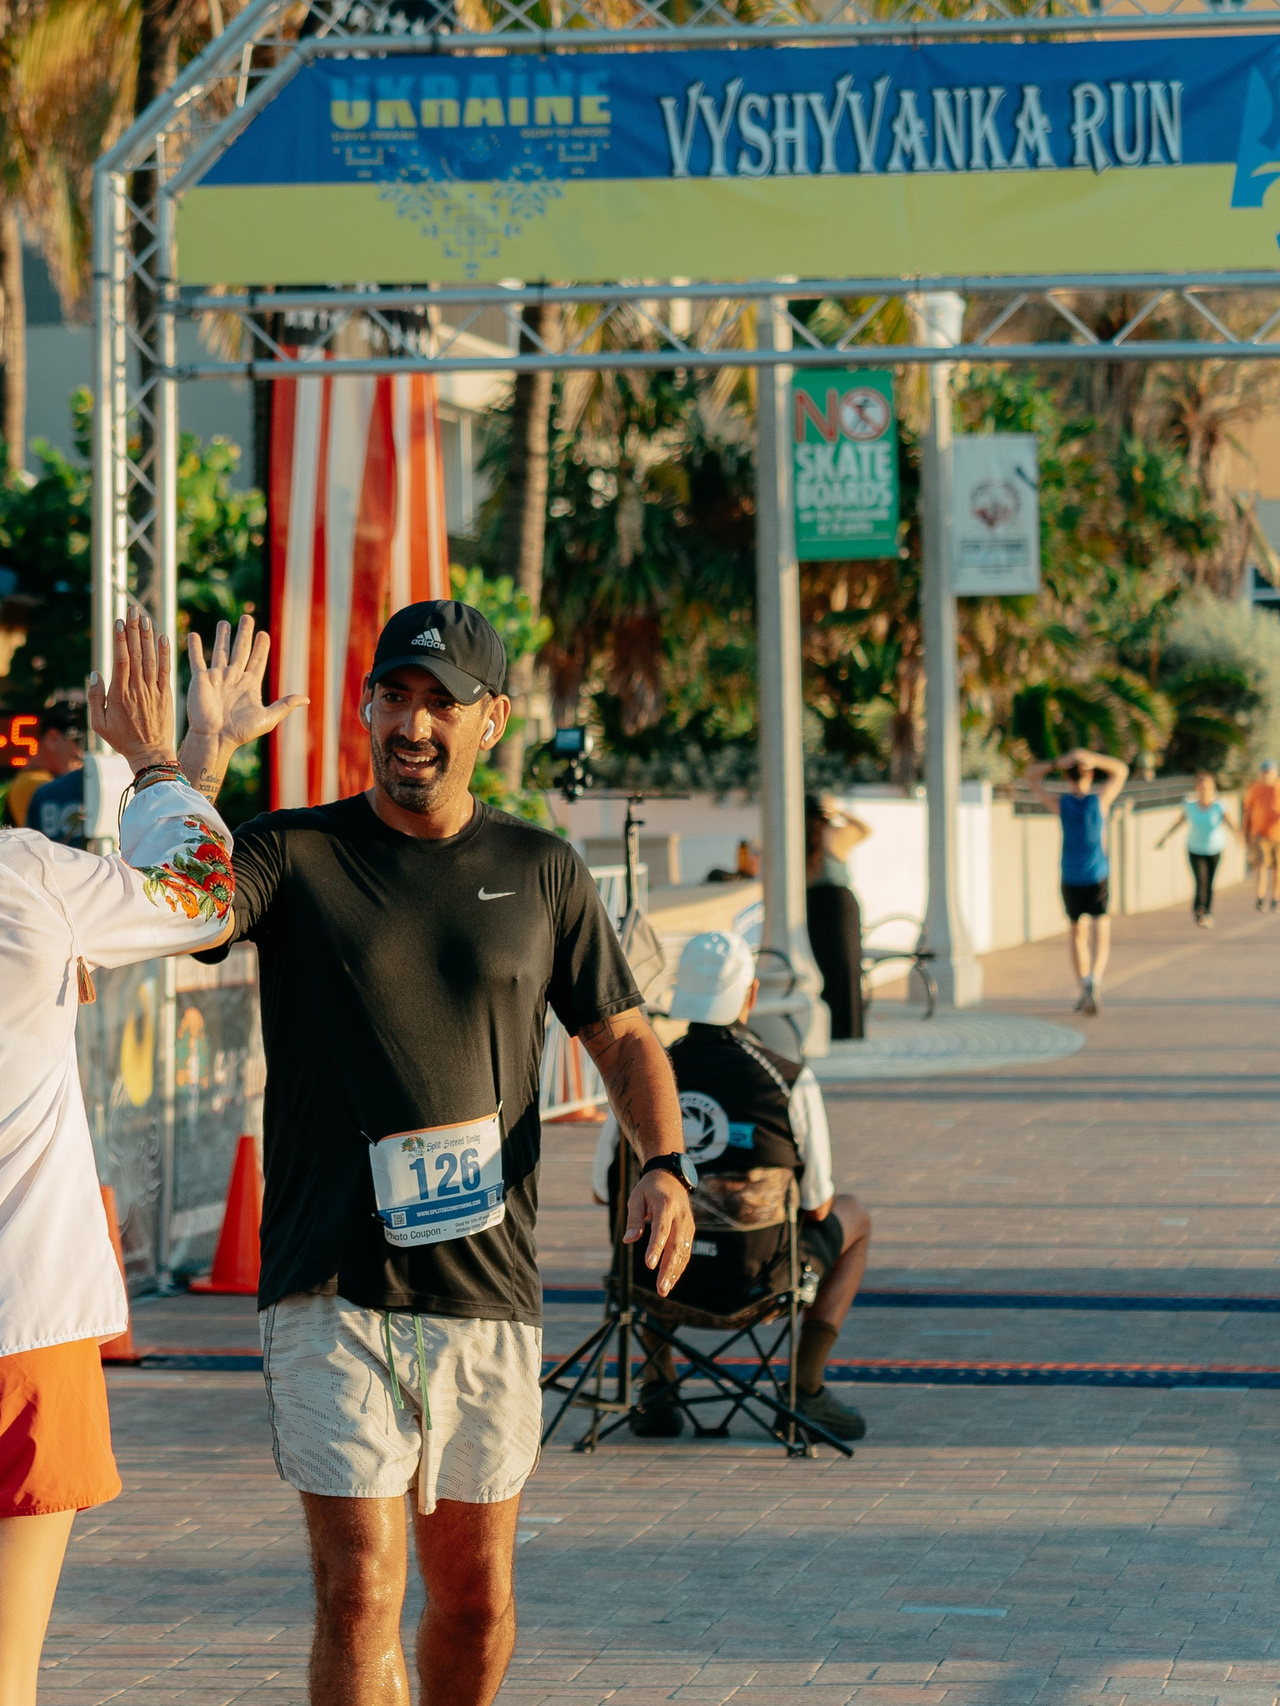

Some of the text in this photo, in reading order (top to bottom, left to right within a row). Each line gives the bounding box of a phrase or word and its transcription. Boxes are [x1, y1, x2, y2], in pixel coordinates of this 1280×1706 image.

[330, 71, 612, 130] UKRAINE
[660, 75, 1186, 180] VYSHYVANKA RUN
[793, 387, 892, 443] NO
[795, 441, 893, 483] SKATE
[796, 481, 893, 510] BOARDS
[411, 637, 447, 651] adidas
[426, 1141, 441, 1153] Split
[443, 1136, 465, 1149] Second
[409, 1148, 482, 1201] 126
[385, 1229, 408, 1241] Photo
[410, 1227, 441, 1239] Coupon
